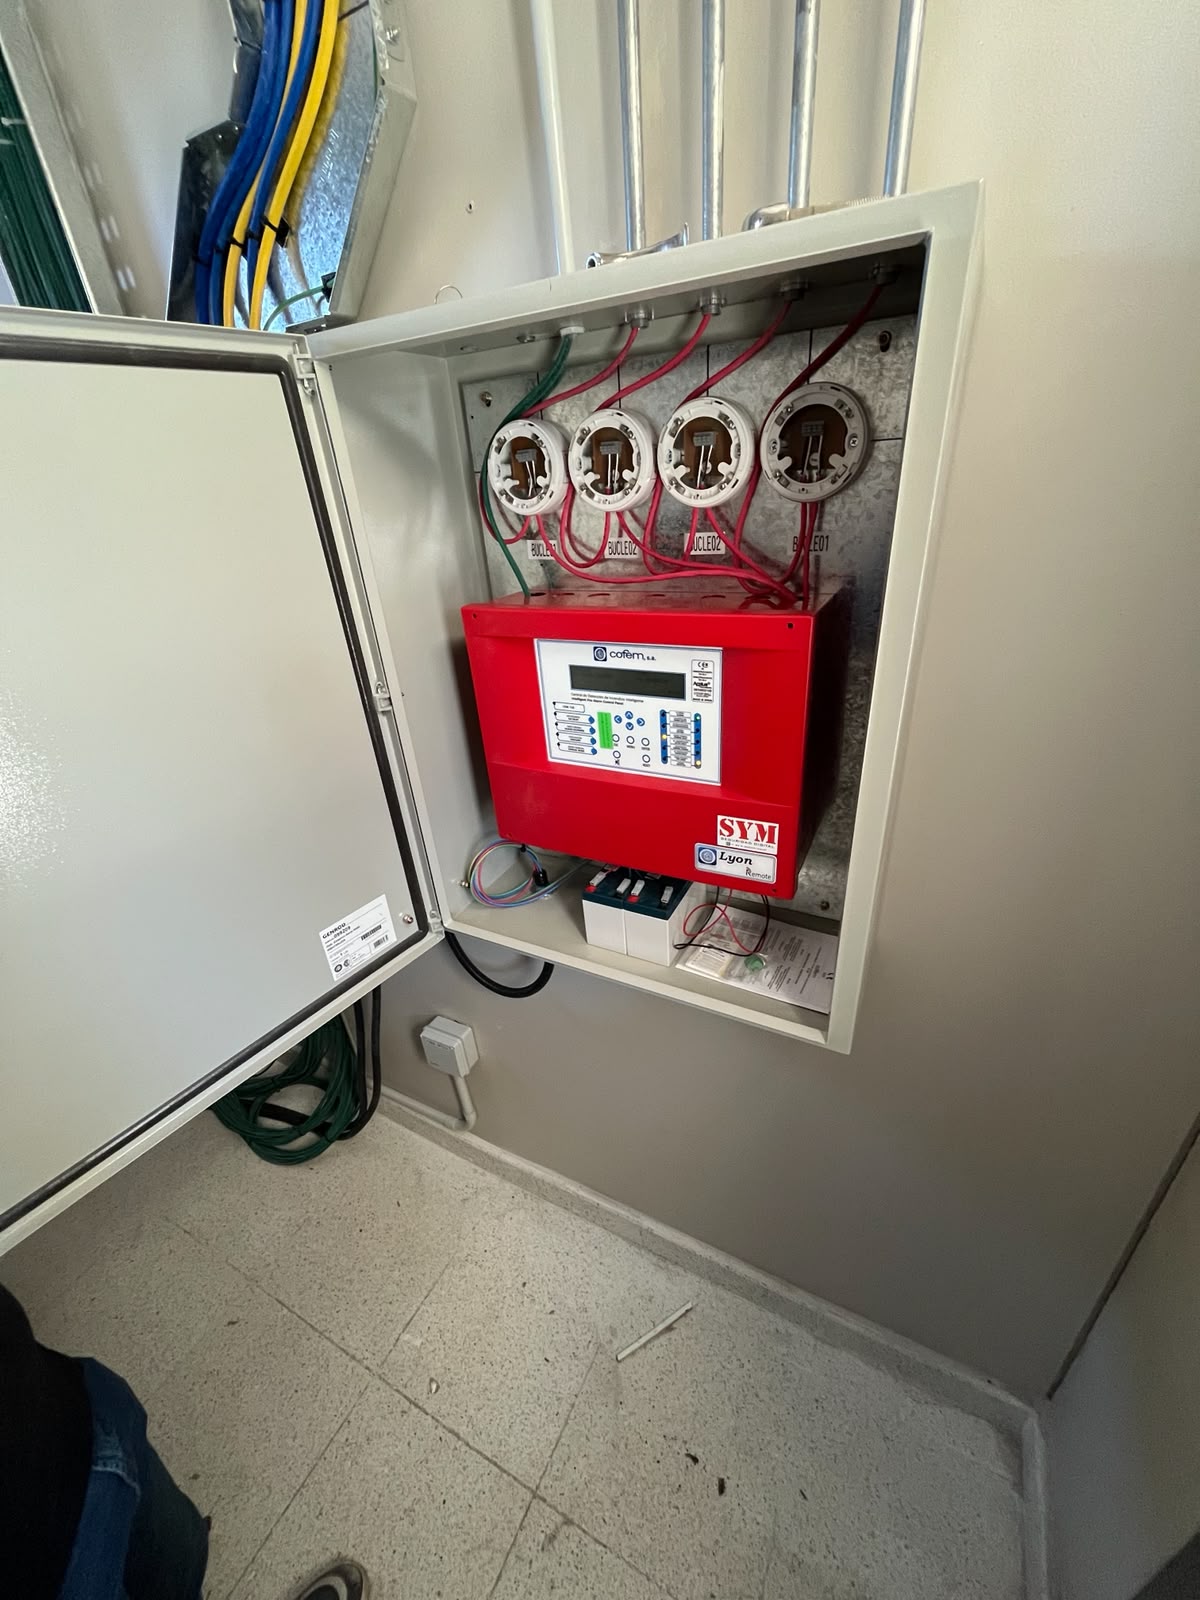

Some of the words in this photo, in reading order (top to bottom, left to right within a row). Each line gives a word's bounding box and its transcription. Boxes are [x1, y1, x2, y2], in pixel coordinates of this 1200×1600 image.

[608, 540, 638, 556] BUCLE02
[691, 535, 721, 552] UCLE02
[719, 818, 777, 845] SYM
[719, 851, 753, 866] Lyon
[745, 867, 772, 880] Remote
